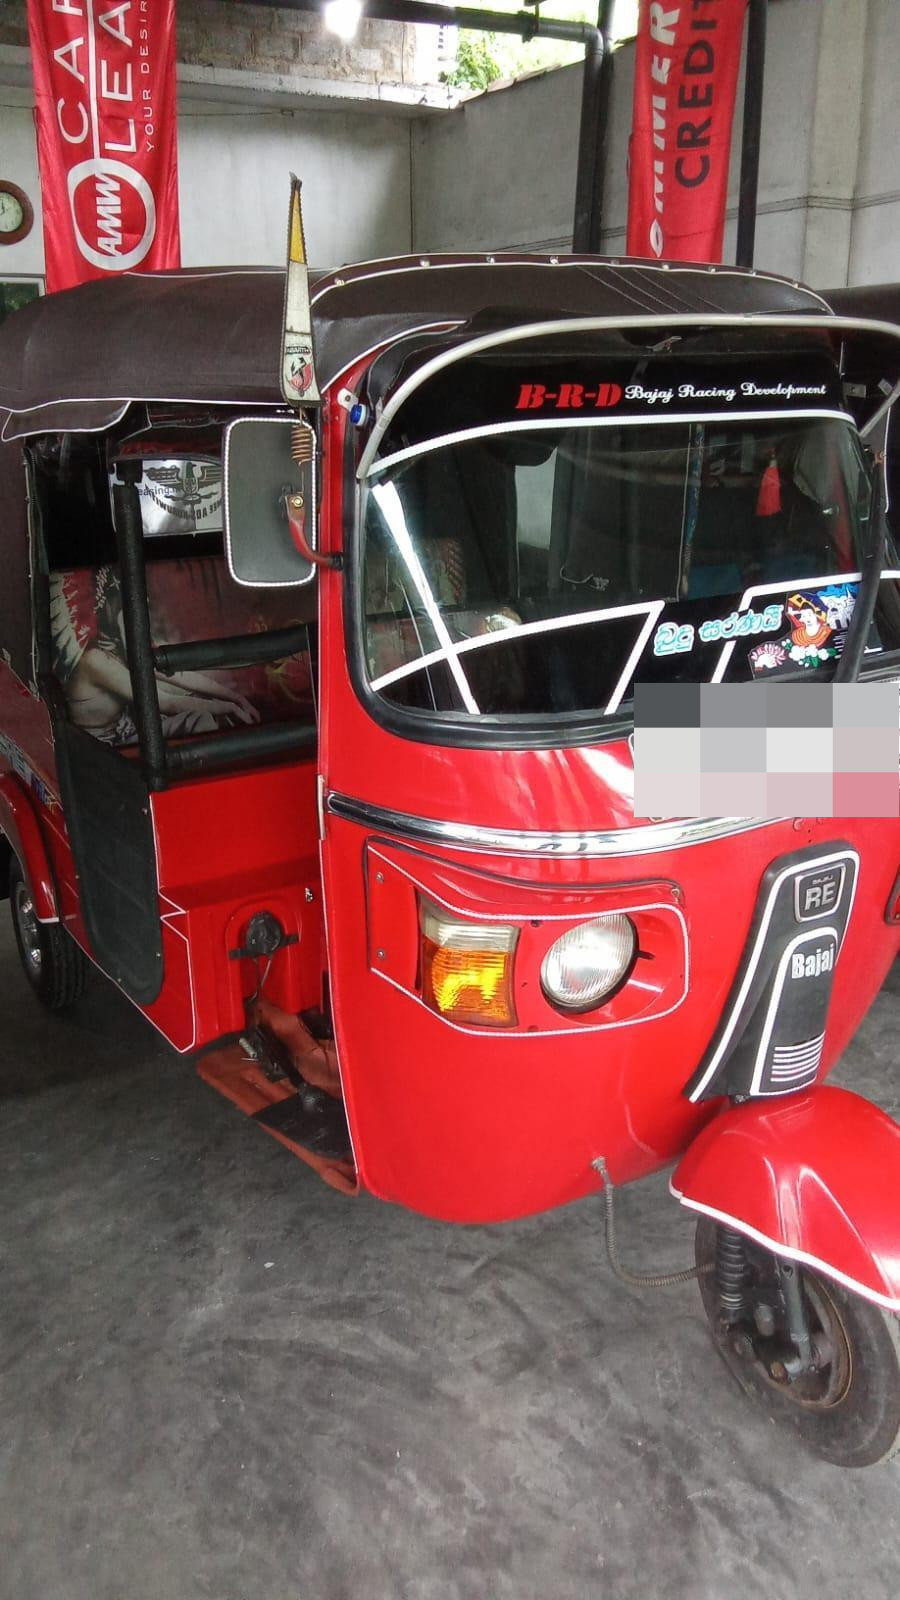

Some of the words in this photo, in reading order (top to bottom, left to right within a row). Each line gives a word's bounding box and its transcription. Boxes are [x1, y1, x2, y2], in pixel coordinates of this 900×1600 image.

[142, 88, 155, 152] YOUR
[95, 171, 123, 257] AMW
[515, 383, 622, 409] B-R-D
[624, 384, 674, 404] Bajaj
[678, 383, 736, 401] Racing
[740, 382, 827, 398] Development
[804, 881, 836, 911] RE
[791, 943, 835, 979] Bajaj
